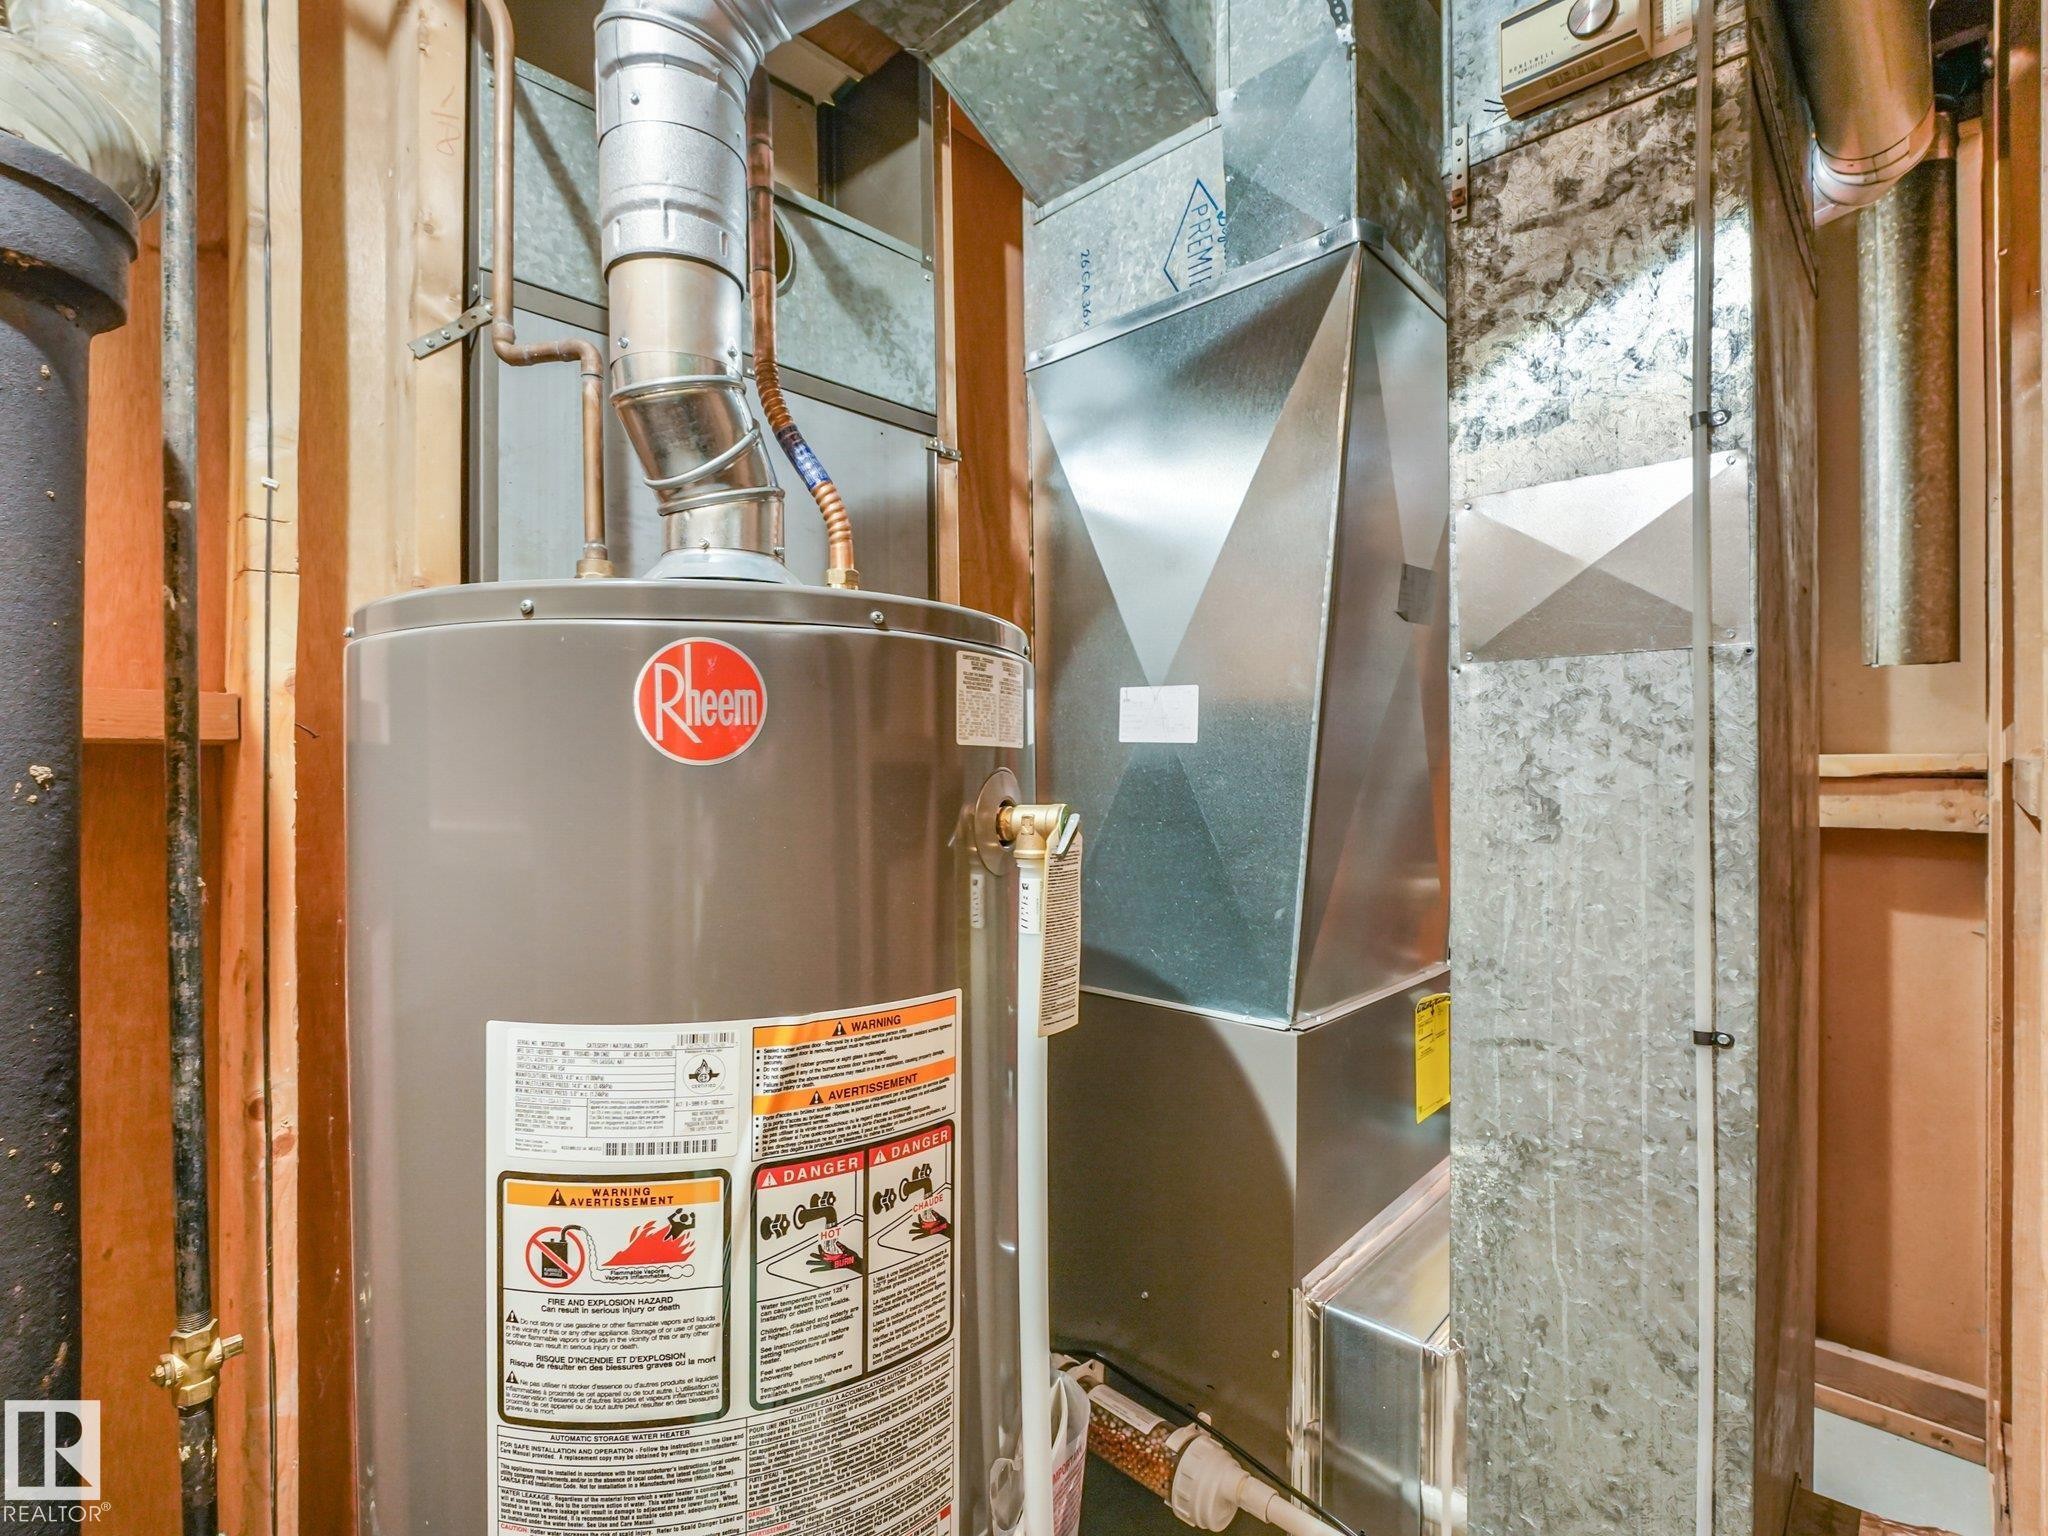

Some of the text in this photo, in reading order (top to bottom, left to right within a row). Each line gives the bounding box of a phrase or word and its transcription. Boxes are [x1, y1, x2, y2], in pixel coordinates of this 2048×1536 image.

[654, 643, 758, 743] Rheem
[851, 1015, 901, 1032] WARNING
[829, 1073, 918, 1101] AVERTISSEMENT
[891, 1129, 948, 1158] DANGER
[783, 1158, 858, 1183] DANGER
[569, 1196, 674, 1207] AVERTISSEMENT
[592, 1188, 651, 1196] WARNING
[913, 1194, 944, 1213] CHAUDE
[820, 1228, 841, 1240] HOT
[644, 1268, 664, 1276] Vapors
[834, 1256, 855, 1269] BURN
[541, 1304, 555, 1312] Can
[622, 1306, 644, 1314] injury
[657, 1303, 680, 1311] death
[548, 1296, 673, 1307] FIRE AND EXPLOSION HAZARD
[760, 1302, 778, 1310] Water
[779, 1293, 816, 1306] temperature
[817, 1290, 831, 1298] over
[773, 1305, 792, 1314] cause
[760, 1311, 787, 1322] instantly
[796, 1305, 813, 1315] death
[814, 1302, 829, 1310] from
[790, 1317, 815, 1329] disabled
[817, 1313, 828, 1322] and
[829, 1309, 848, 1319] elderly
[849, 1306, 859, 1314] are
[575, 1321, 600, 1329] gasoline
[660, 1319, 681, 1327] vapors
[695, 1315, 716, 1324] liquids
[767, 1329, 791, 1340] highest
[792, 1326, 803, 1335] risk
[812, 1321, 829, 1330] being
[760, 1349, 782, 1359] setting
[783, 1340, 819, 1354] temperature
[828, 1334, 843, 1343] water
[773, 1338, 806, 1350] instruction
[807, 1331, 830, 1342] manual
[830, 1327, 849, 1337] before
[509, 1358, 533, 1369] Risque
[646, 1362, 672, 1371] graves
[687, 1358, 695, 1366] la
[697, 1355, 716, 1365] mort
[536, 1355, 565, 1363] RISQUE
[567, 1356, 613, 1364] D'INCENDIE
[629, 1353, 685, 1363] D'EXPLOSION
[760, 1366, 773, 1375] Feel
[775, 1363, 791, 1372] water
[793, 1358, 812, 1367] before
[813, 1352, 836, 1362] bathing
[760, 1379, 798, 1393] Temperature
[800, 1373, 822, 1383] limiting
[823, 1368, 842, 1377] valves
[789, 1395, 833, 1414] CHAUFFE-EAU
[840, 1376, 886, 1399] ACCUMULATION
[885, 1360, 922, 1382] AUTOMATIQUE
[790, 1385, 801, 1393] see
[749, 1425, 764, 1434] POUR
[766, 1422, 777, 1431] UNE
[778, 1411, 816, 1428] INSTALLATION
[833, 1388, 877, 1411] FONCTIONNEMENT
[500, 1440, 512, 1448] FOR
[513, 1442, 529, 1450] SAFE
[530, 1444, 576, 1453] INSTALLATION
[669, 1441, 703, 1450] instructions
[733, 1432, 744, 1440] and
[631, 1433, 658, 1441] WATER
[659, 1430, 690, 1439] HEATER
[501, 1489, 549, 1500] WATER LEAKAGE
